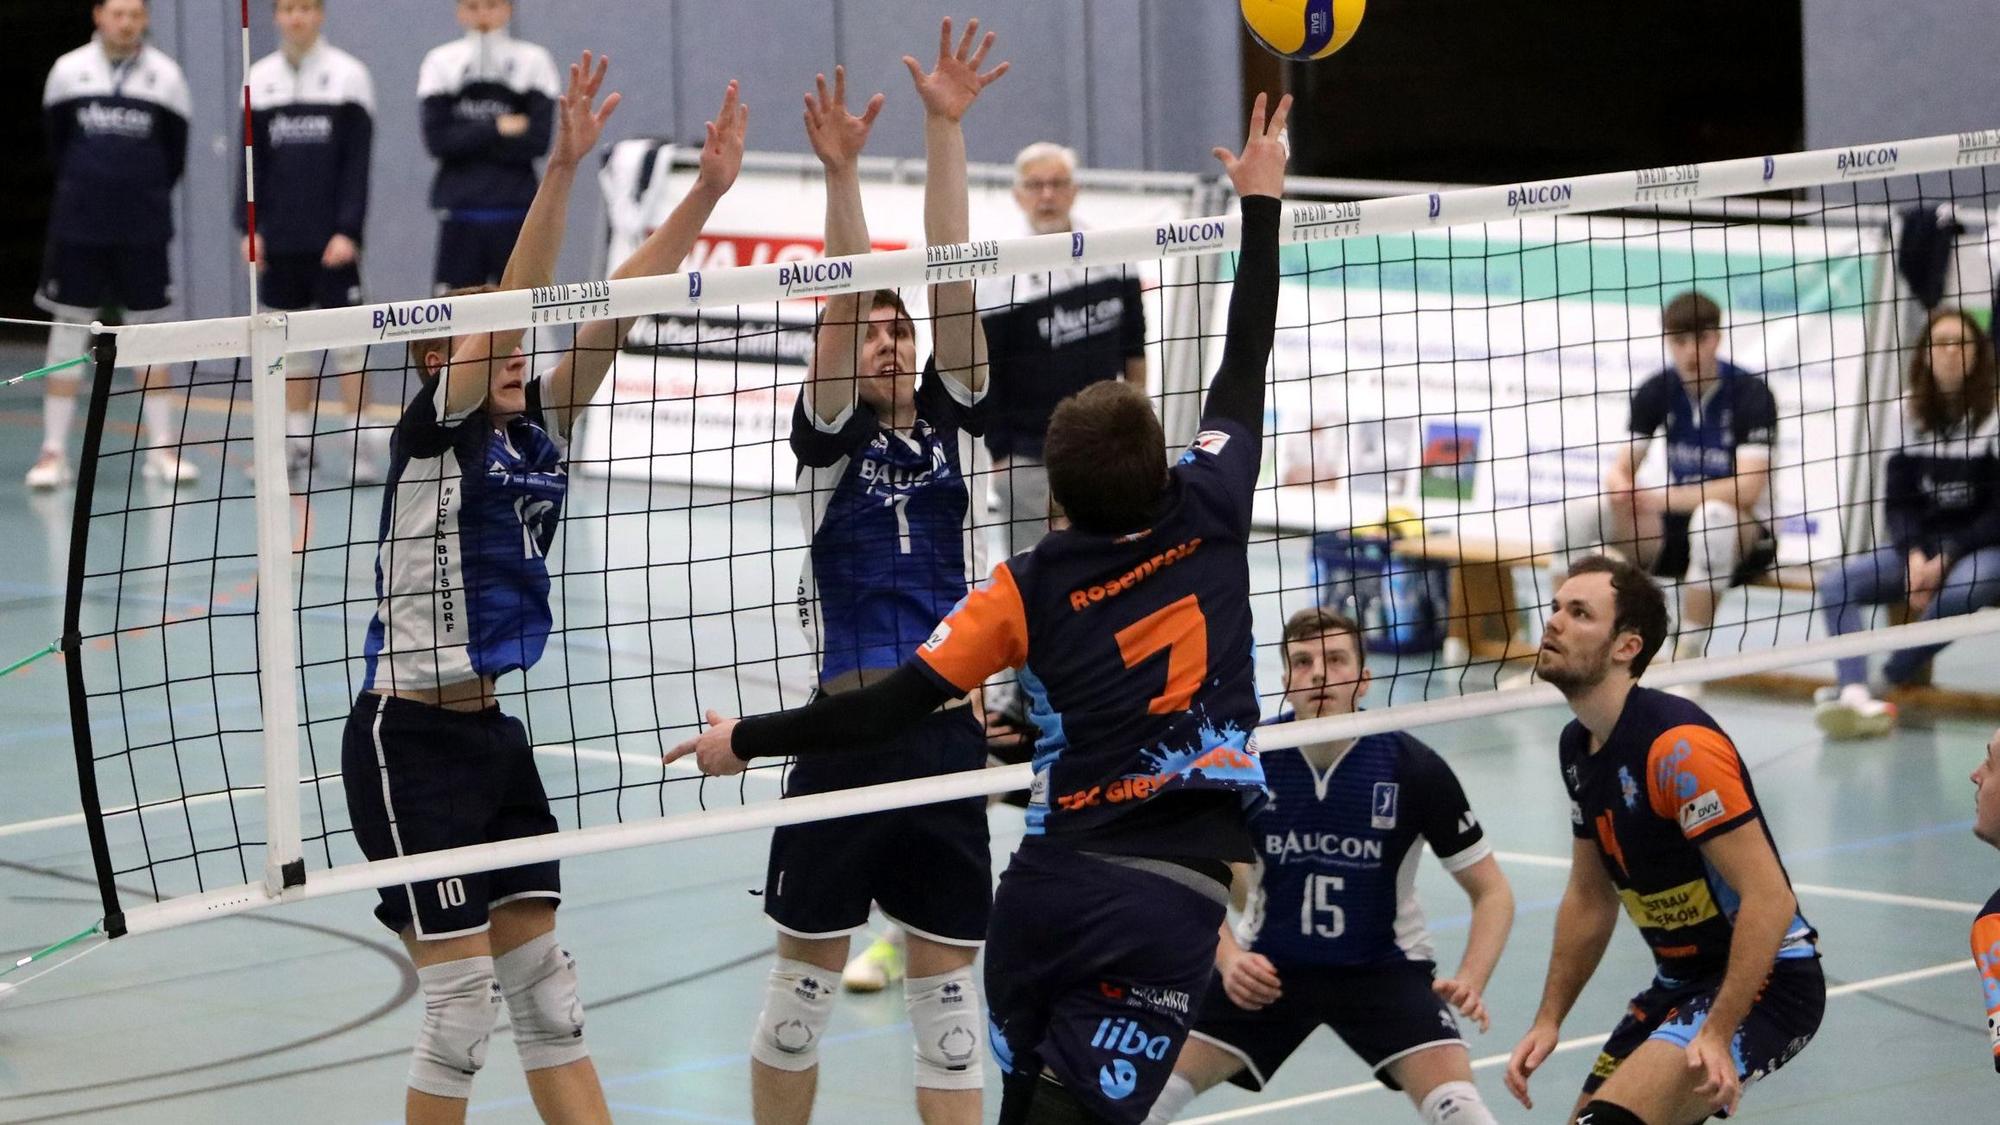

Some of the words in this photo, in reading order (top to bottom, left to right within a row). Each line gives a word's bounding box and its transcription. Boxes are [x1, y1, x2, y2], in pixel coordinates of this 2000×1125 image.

[1837, 148, 1898, 178] BAUCON
[1508, 184, 1572, 216] BAUCON
[925, 240, 999, 263] RHEIN-SIEG
[1156, 221, 1225, 256] BAUCON
[531, 280, 610, 304] RHEIN-SIEG
[779, 261, 853, 297] BAUCON
[372, 303, 452, 340] BAUCON
[531, 303, 609, 323] VOLLEYS
[437, 545, 454, 633] BUISDORF
[1114, 593, 1208, 715] 7
[1697, 801, 1719, 818] DVV
[1265, 829, 1382, 865] BAUCON
[436, 877, 467, 910] 10
[1301, 873, 1345, 938] 15
[1646, 891, 1690, 912] STBAU
[1091, 1017, 1171, 1061] liba
